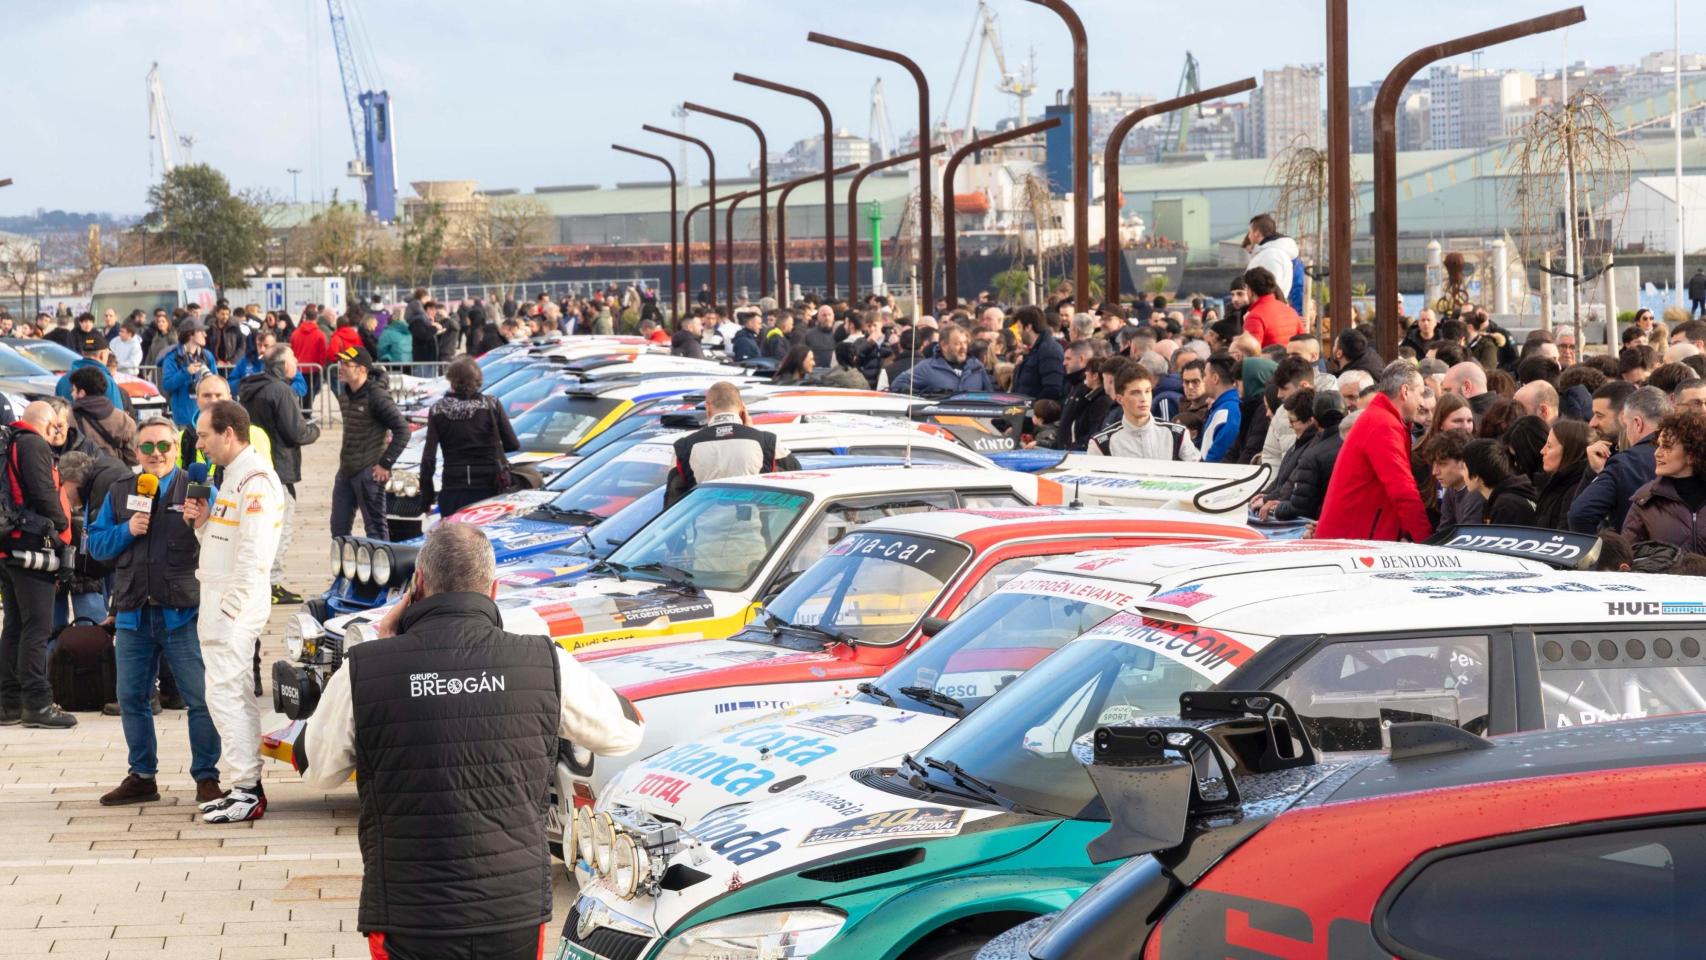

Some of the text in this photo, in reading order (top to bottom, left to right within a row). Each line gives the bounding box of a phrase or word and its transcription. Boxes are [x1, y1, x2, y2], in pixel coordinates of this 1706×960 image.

[974, 437, 1015, 450] KINTO
[1443, 534, 1581, 559] CITROËN
[1351, 555, 1463, 569] I BENIDORM
[1020, 579, 1072, 593] CITROËN
[1070, 583, 1134, 606] LEVANTE
[1412, 581, 1646, 599] Skoda
[1604, 602, 1660, 615] HVC
[410, 672, 439, 681] GRUPO
[410, 671, 505, 697] BREOGÁN
[281, 684, 299, 700] BOSCH
[1103, 713, 1128, 721] SPORT
[722, 724, 838, 767] Costa
[644, 743, 776, 797] Blanca
[632, 773, 693, 806] TOTAL
[852, 807, 919, 832] 30
